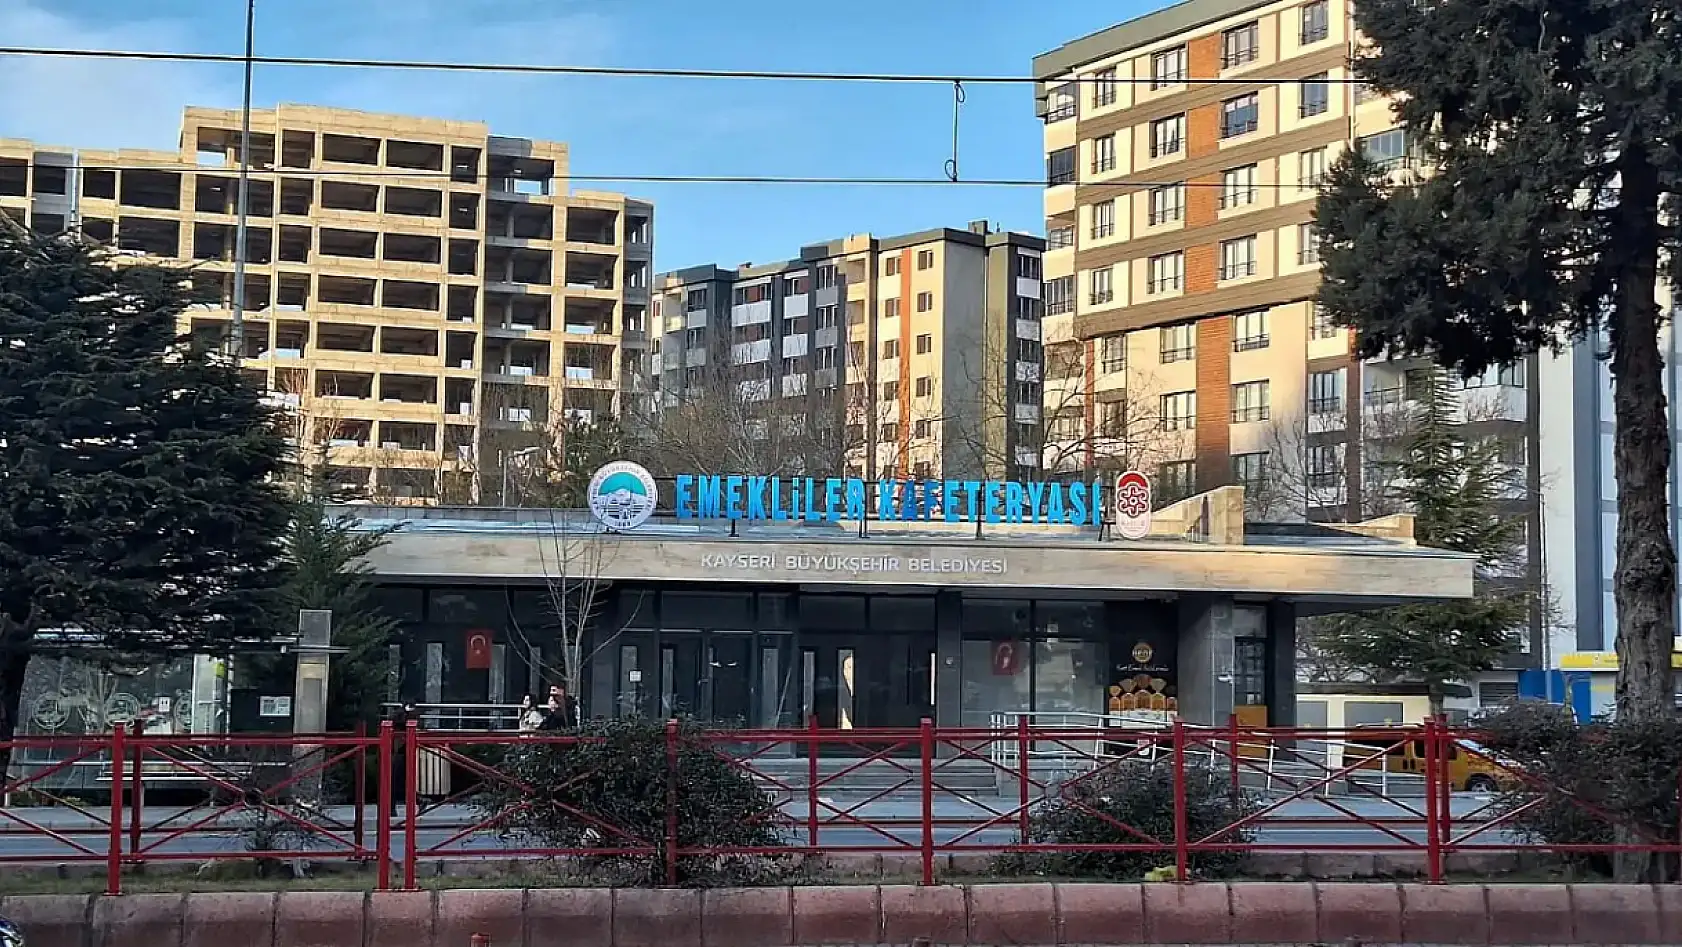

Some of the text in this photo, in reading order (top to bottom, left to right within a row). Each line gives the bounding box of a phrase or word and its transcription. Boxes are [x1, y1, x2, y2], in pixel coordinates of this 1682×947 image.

[879, 480, 1100, 526] KAFETERYASI
[701, 553, 1008, 574] KAYSERİ BÜYÜKŞEHİR BELEDİYESİ
